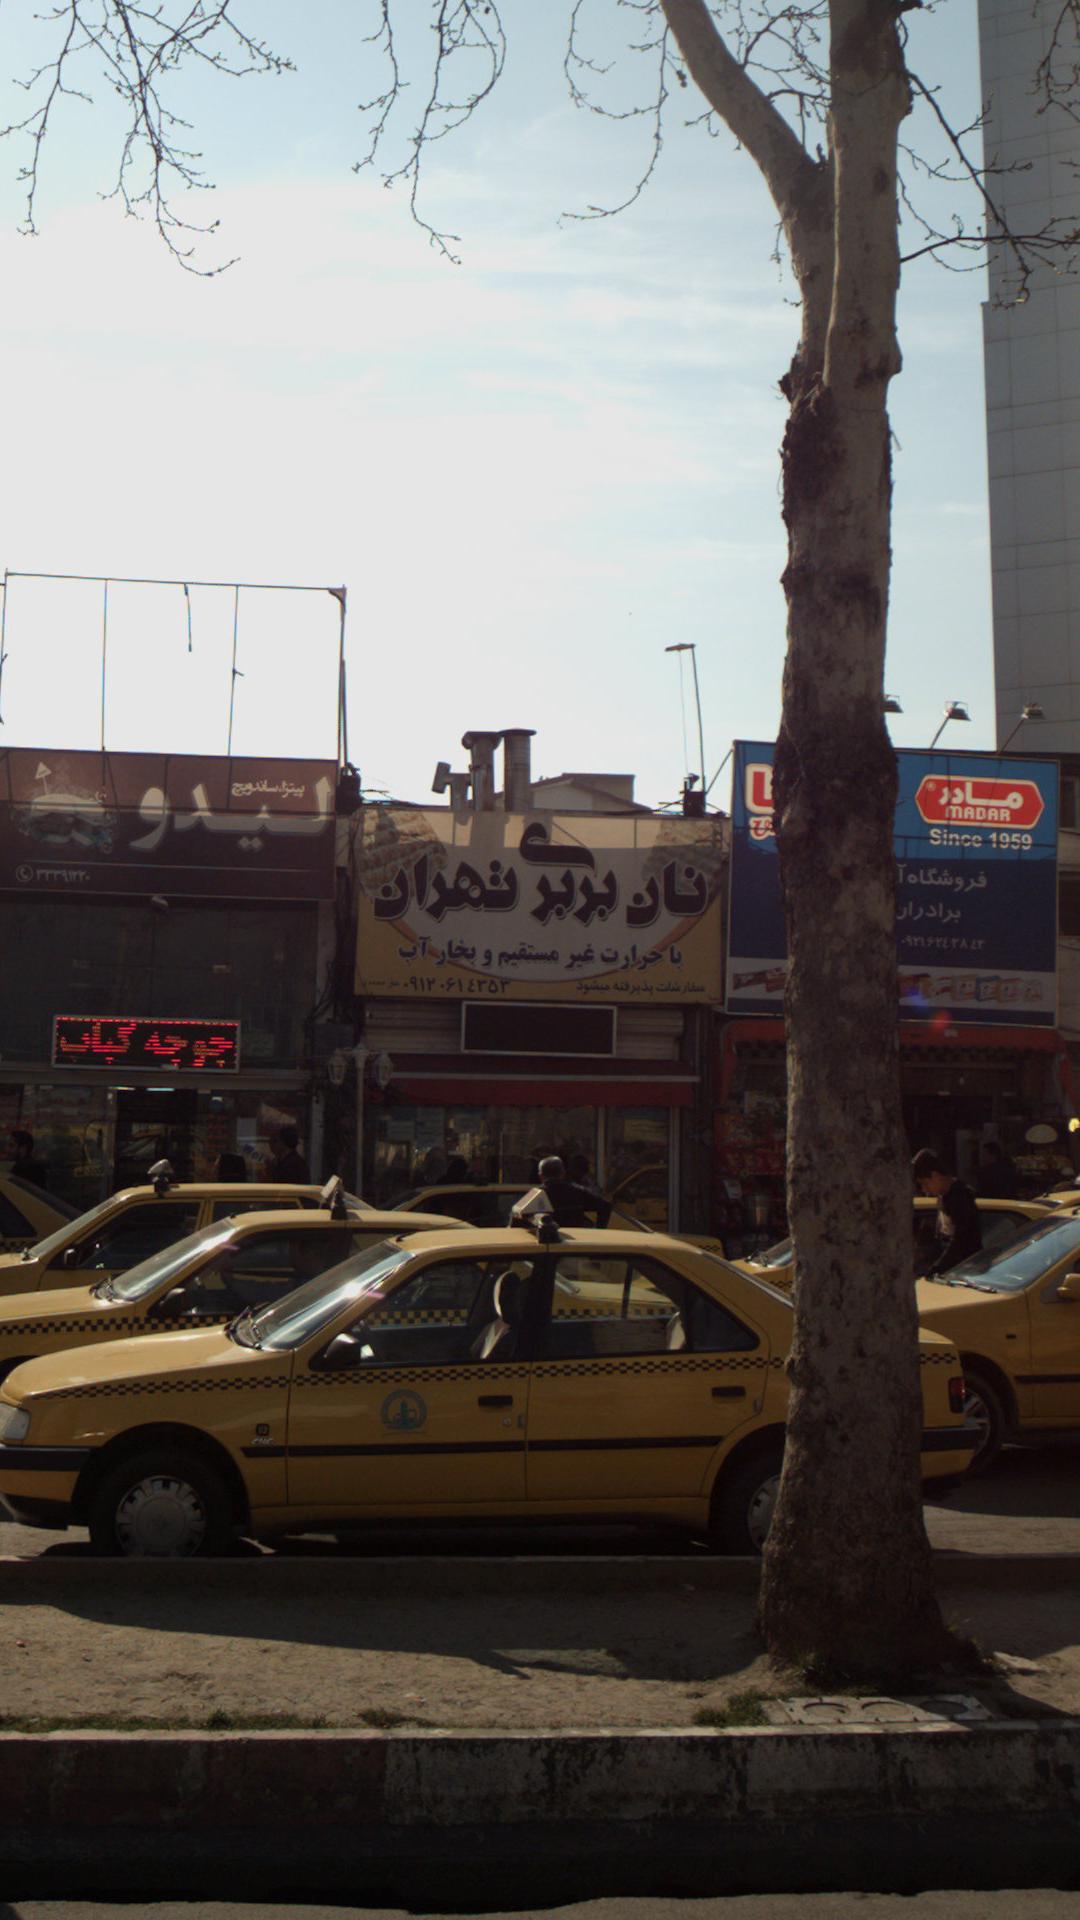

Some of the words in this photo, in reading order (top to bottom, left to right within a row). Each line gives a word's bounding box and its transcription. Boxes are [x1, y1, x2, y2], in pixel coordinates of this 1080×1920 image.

[938, 781, 1025, 810] مادر
[944, 805, 1012, 823] MADAR
[928, 827, 983, 848] Since
[989, 831, 1033, 851] 1959
[373, 853, 519, 924] تهران
[907, 867, 988, 893] فروشگاه
[626, 860, 709, 929] نان
[398, 936, 431, 961] آب
[435, 938, 477, 967] بخار
[482, 949, 492, 967] و
[498, 942, 559, 968] مستقیم
[564, 942, 594, 969] غیر
[600, 944, 663, 971] حرارت
[669, 943, 683, 966] با
[655, 980, 706, 995] سفارشات
[143, 1031, 235, 1068] جوجه
